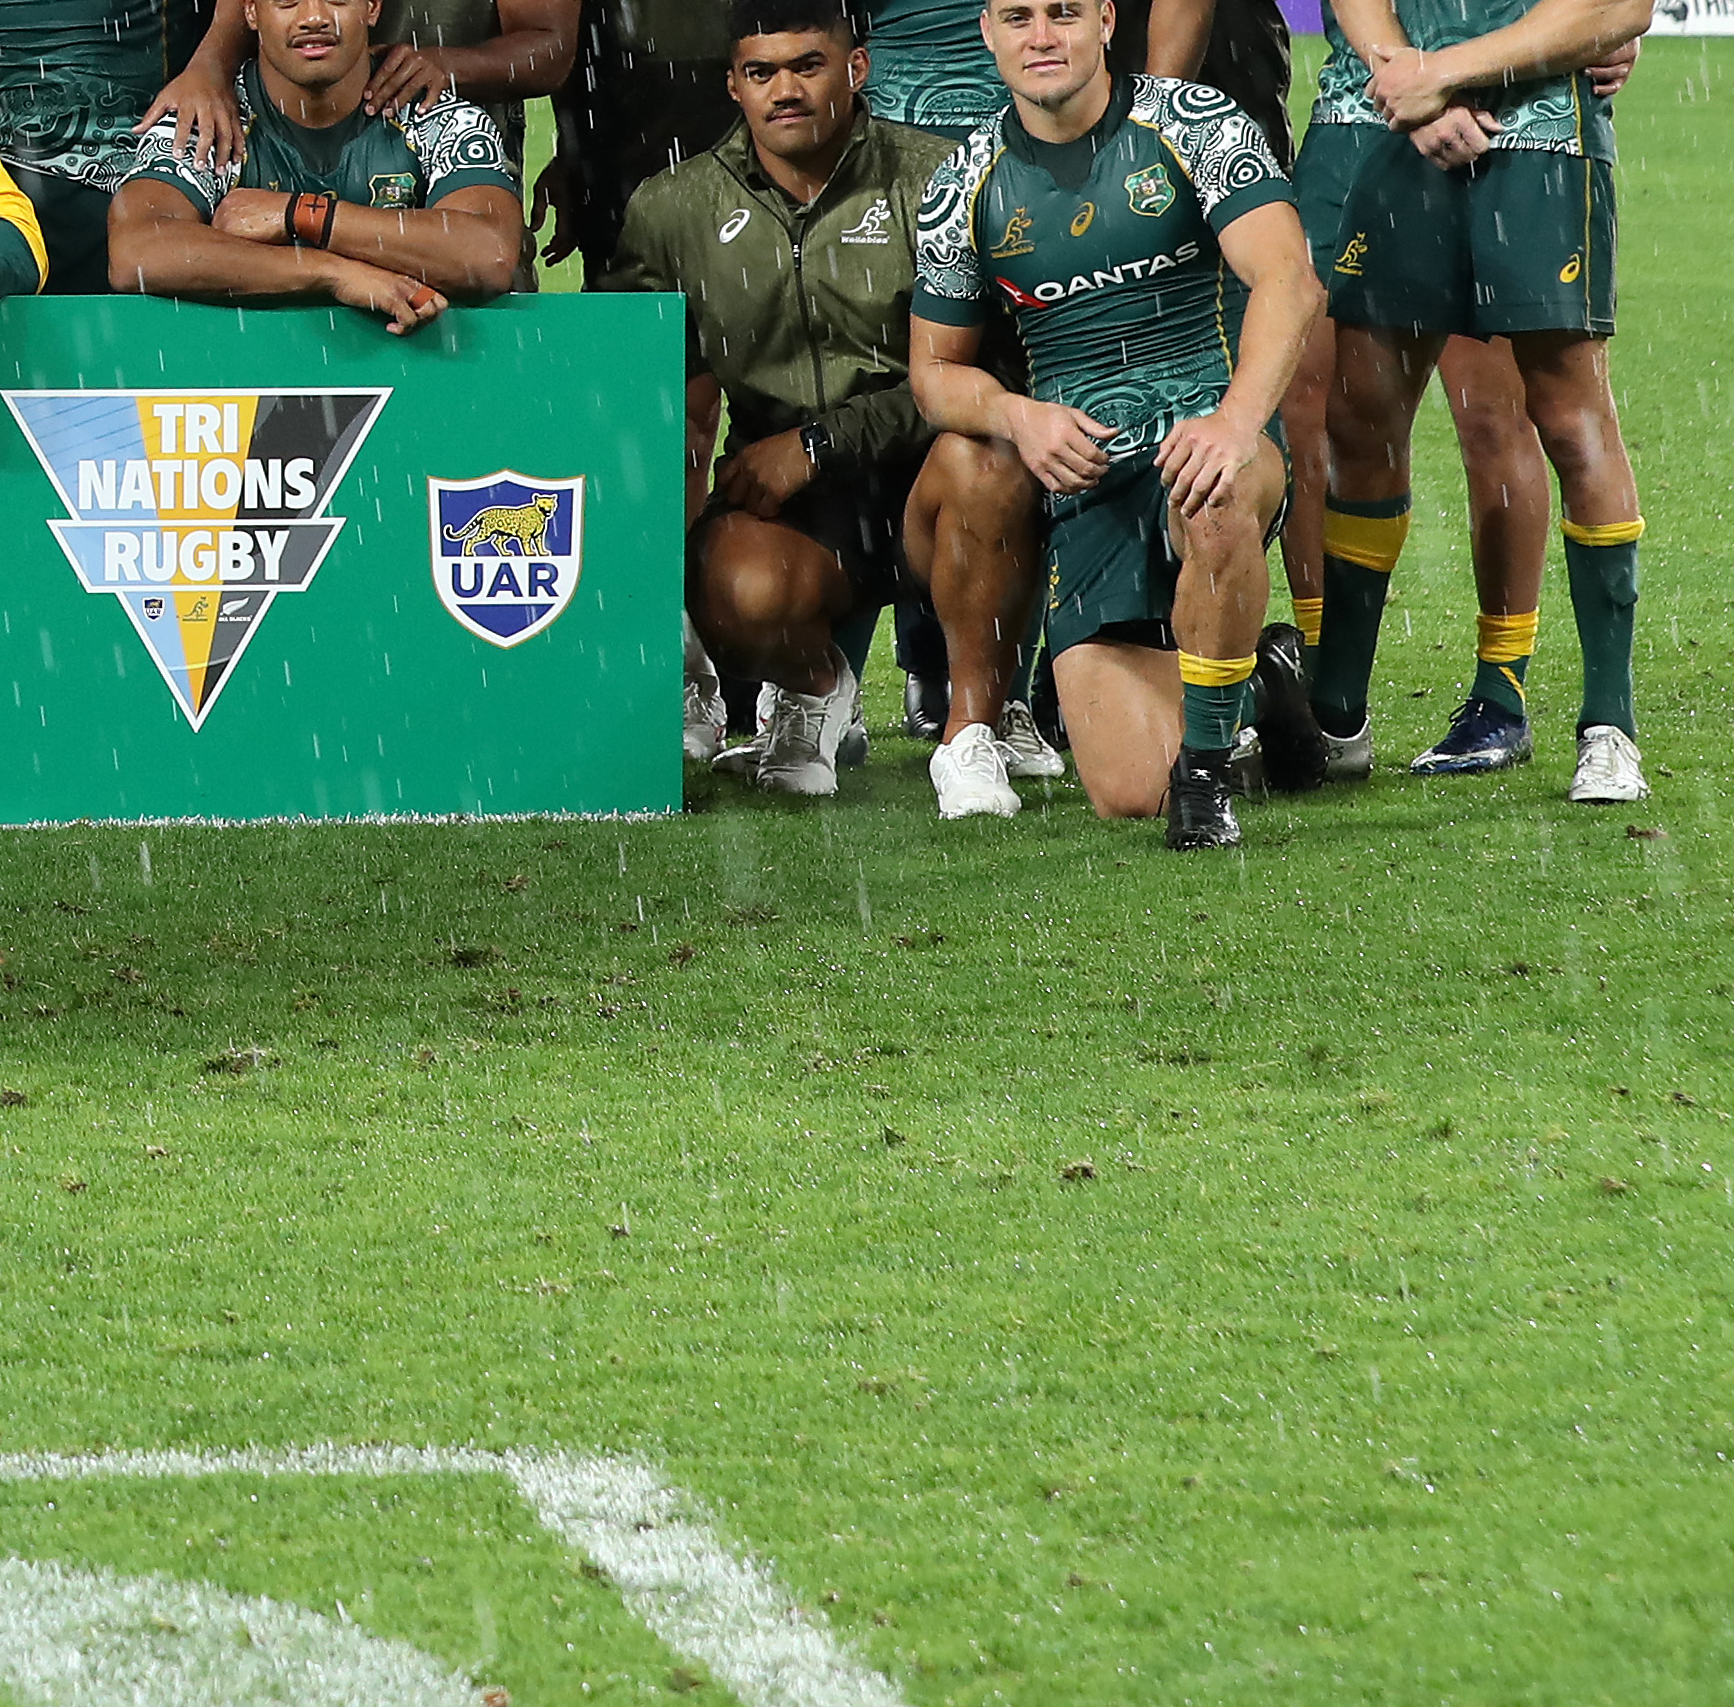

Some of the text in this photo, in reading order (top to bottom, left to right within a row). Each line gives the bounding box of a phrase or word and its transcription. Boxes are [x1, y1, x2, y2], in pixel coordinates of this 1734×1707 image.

[840, 235, 891, 245] Wallabies
[1034, 239, 1200, 303] QANTAS
[152, 401, 239, 455] TRI
[77, 457, 320, 512] NATIONS
[103, 529, 290, 585] RUGBY
[451, 561, 560, 599] UAR
